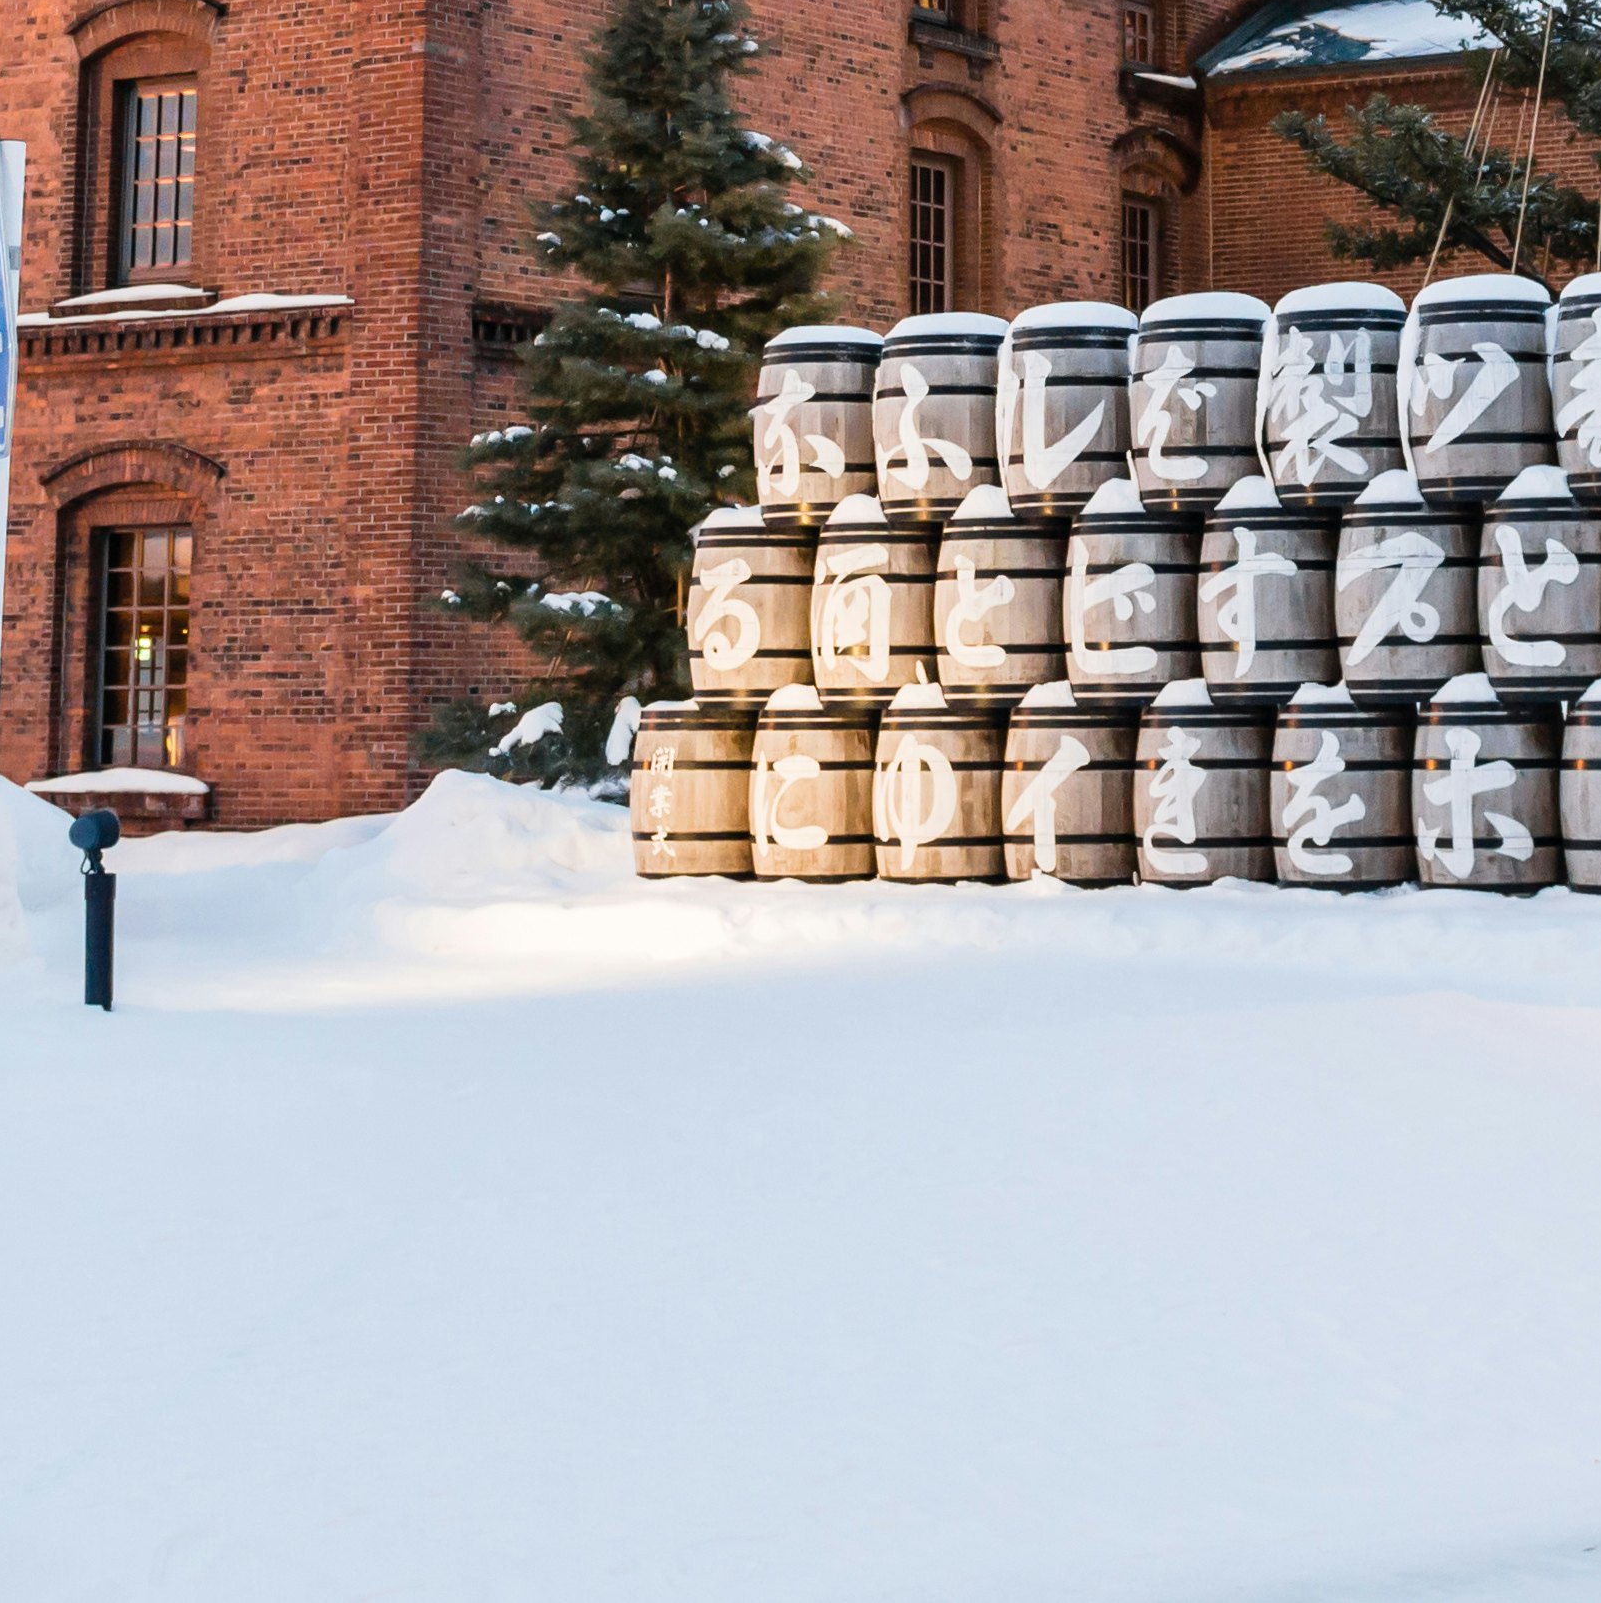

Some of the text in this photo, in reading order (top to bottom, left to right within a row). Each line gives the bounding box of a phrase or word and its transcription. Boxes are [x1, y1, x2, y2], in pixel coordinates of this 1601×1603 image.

[694, 558, 760, 671] る
[945, 554, 1015, 668] と
[1200, 527, 1297, 678] す
[1488, 524, 1580, 667] と
[753, 749, 829, 857] に
[874, 733, 957, 871] ゆ
[1282, 730, 1366, 875] を
